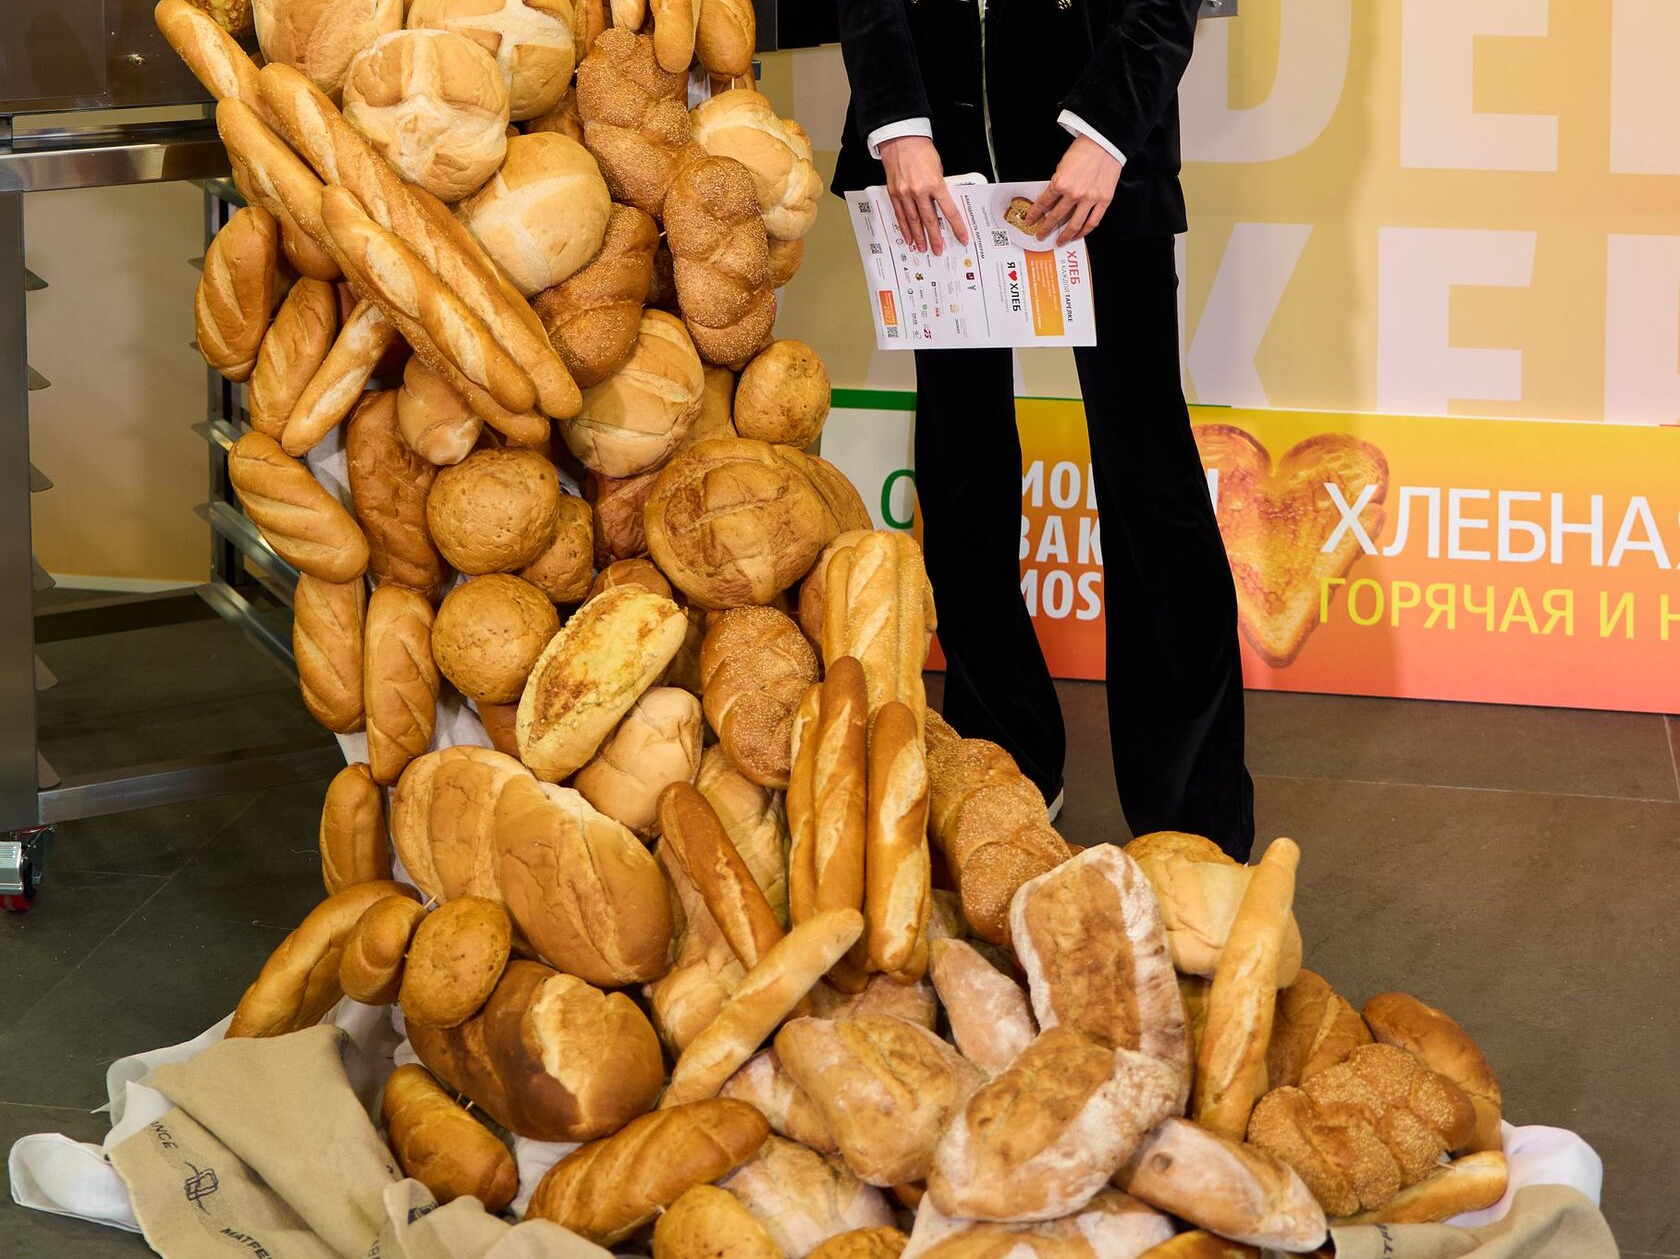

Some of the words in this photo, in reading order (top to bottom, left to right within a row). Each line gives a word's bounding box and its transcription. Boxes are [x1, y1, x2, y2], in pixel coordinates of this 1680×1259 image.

[1006, 261, 1016, 269] Я
[1066, 250, 1081, 285] ХЛЕБ
[1009, 283, 1021, 312] ХЛЕБ
[1064, 294, 1073, 322] ТАРЕЛКЕ
[1319, 481, 1680, 570] ХЛЕБНА
[1319, 576, 1575, 636] ГОРЯЧАЯ
[1600, 590, 1635, 639] И
[220, 1227, 273, 1259] MATFE
